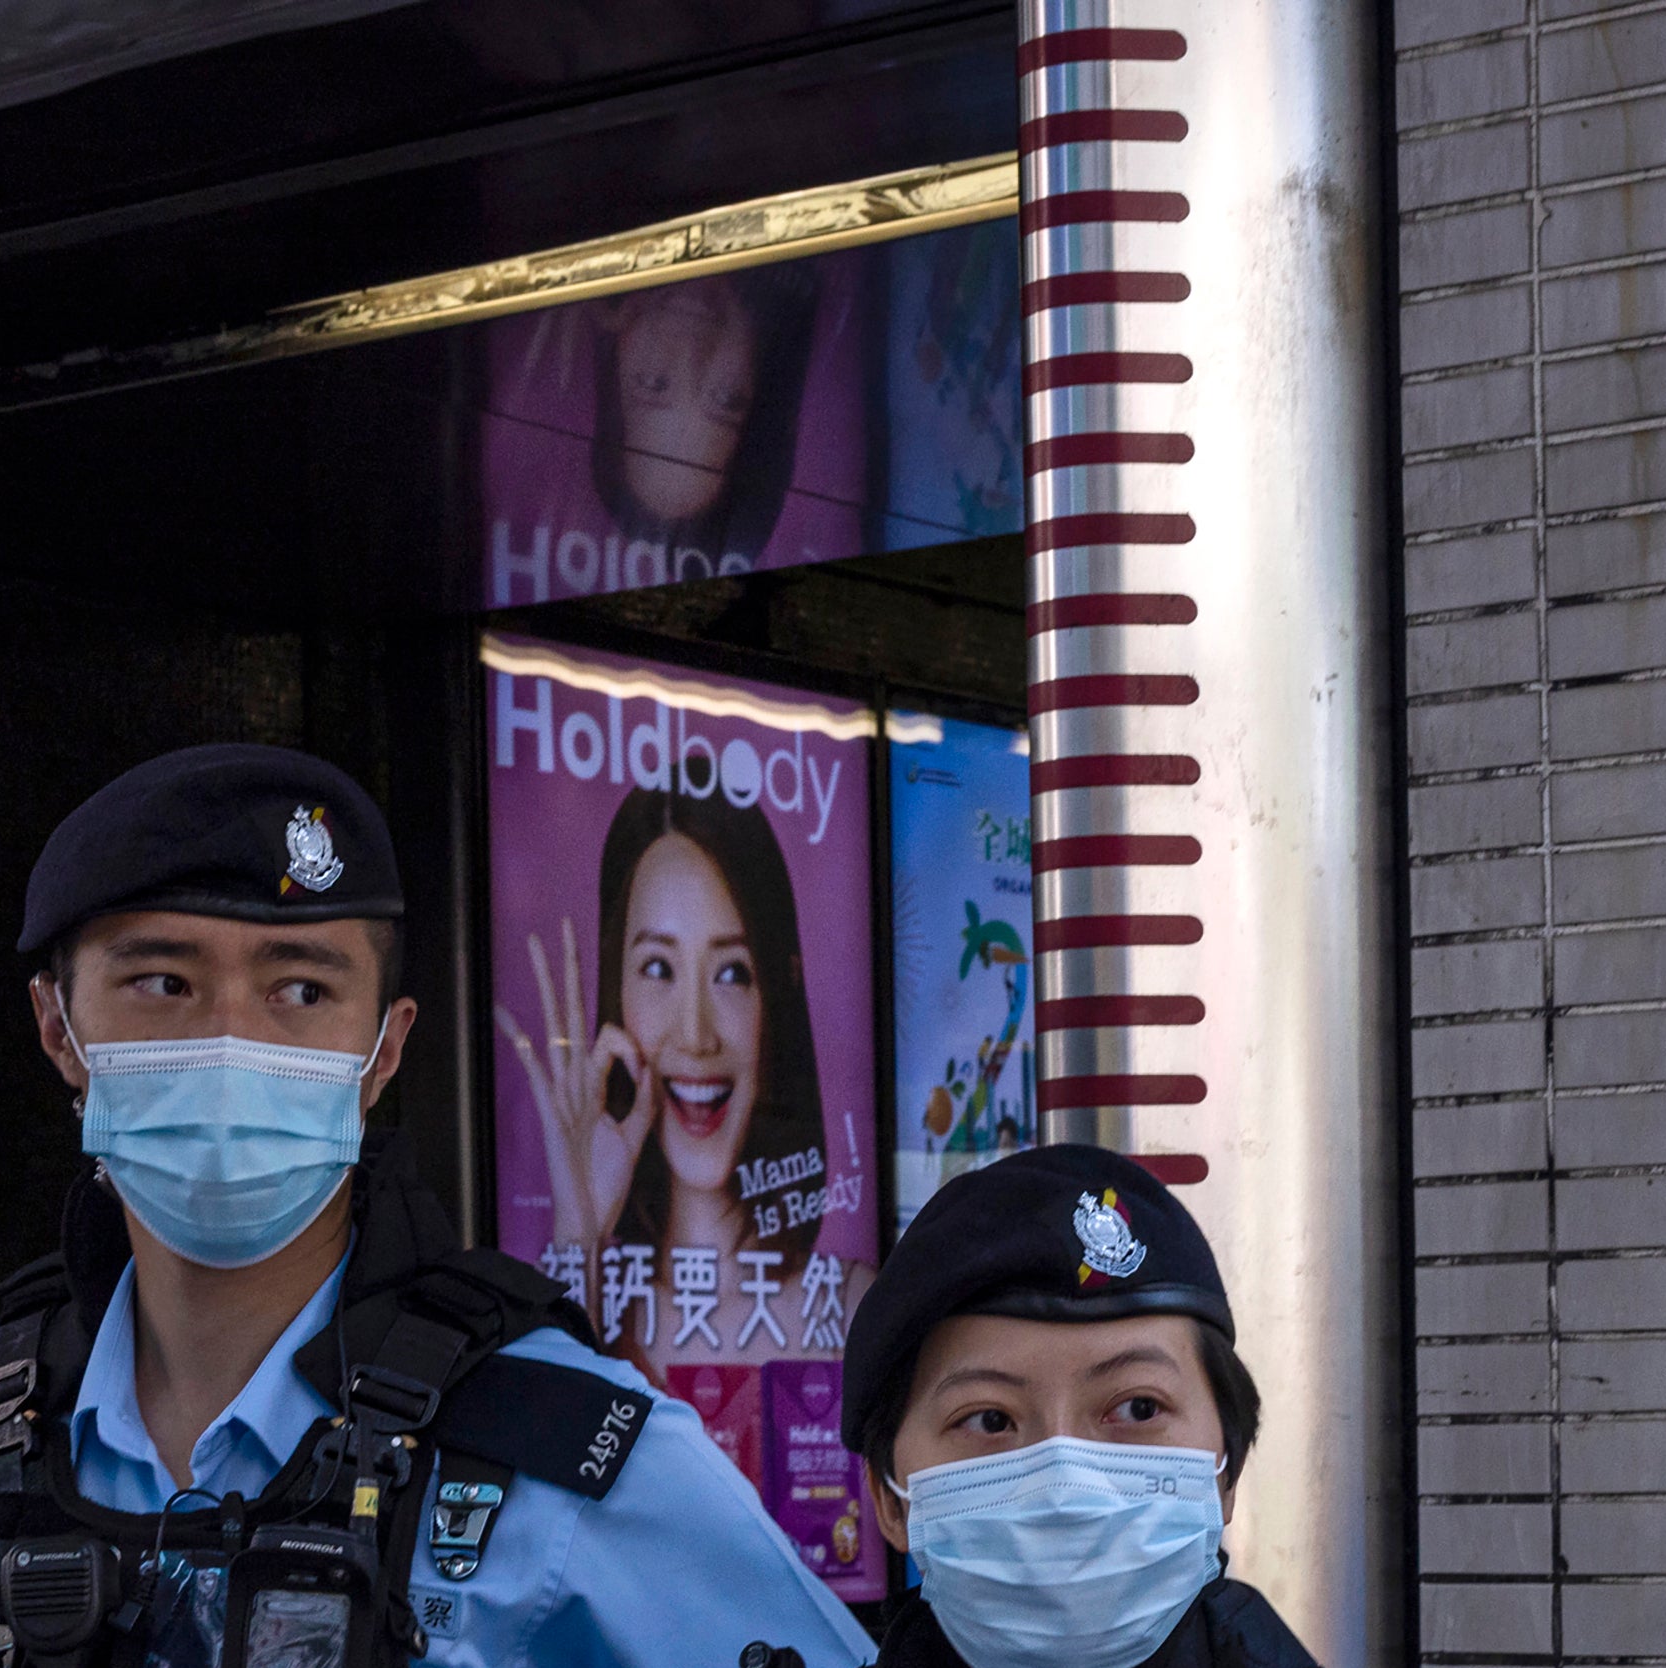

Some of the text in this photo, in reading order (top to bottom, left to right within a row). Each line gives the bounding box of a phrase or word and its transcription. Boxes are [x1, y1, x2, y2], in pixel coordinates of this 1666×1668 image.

[496, 672, 841, 844] Holdbody
[735, 1146, 824, 1199] Mama
[753, 1204, 782, 1239] is
[578, 1399, 637, 1482] 24976
[280, 1540, 344, 1555] MOTOROLA
